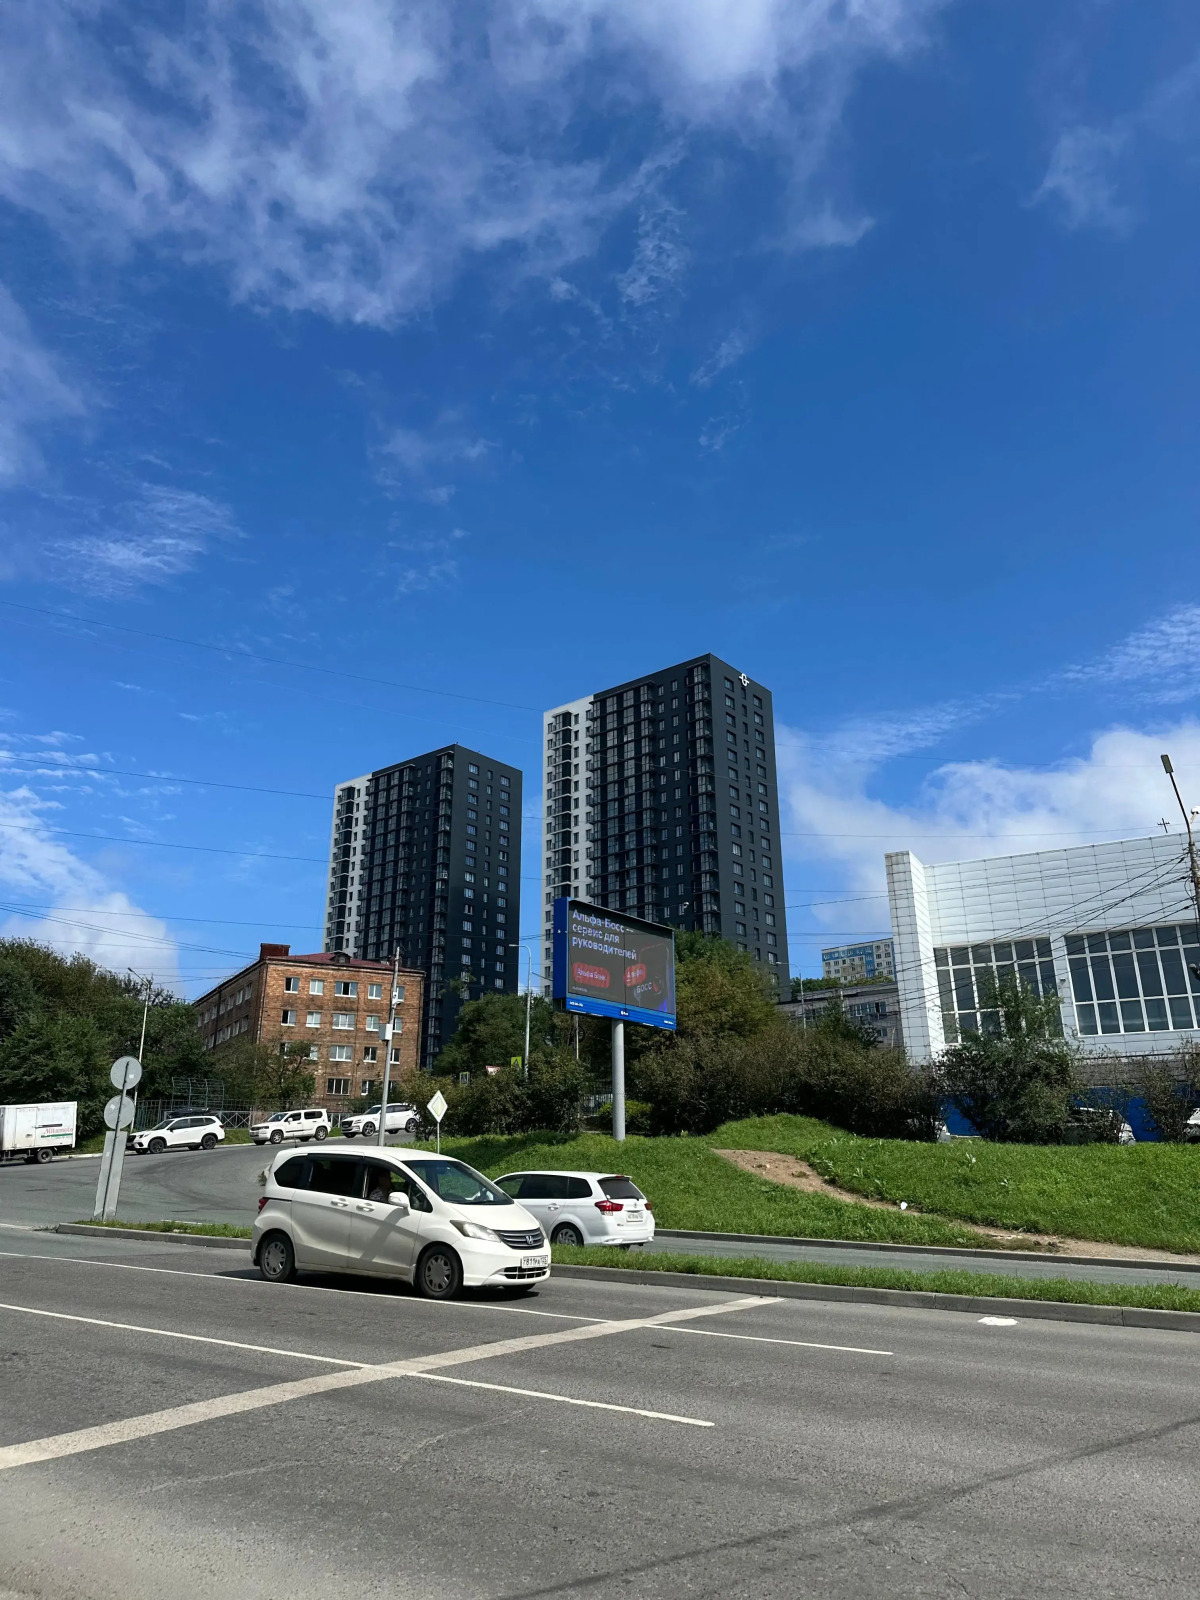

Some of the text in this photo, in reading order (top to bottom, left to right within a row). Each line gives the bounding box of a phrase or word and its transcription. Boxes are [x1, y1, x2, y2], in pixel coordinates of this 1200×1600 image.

[572, 909, 625, 933] Альфа-Босс
[572, 923, 620, 944] сервис для
[572, 936, 637, 960] руководителей
